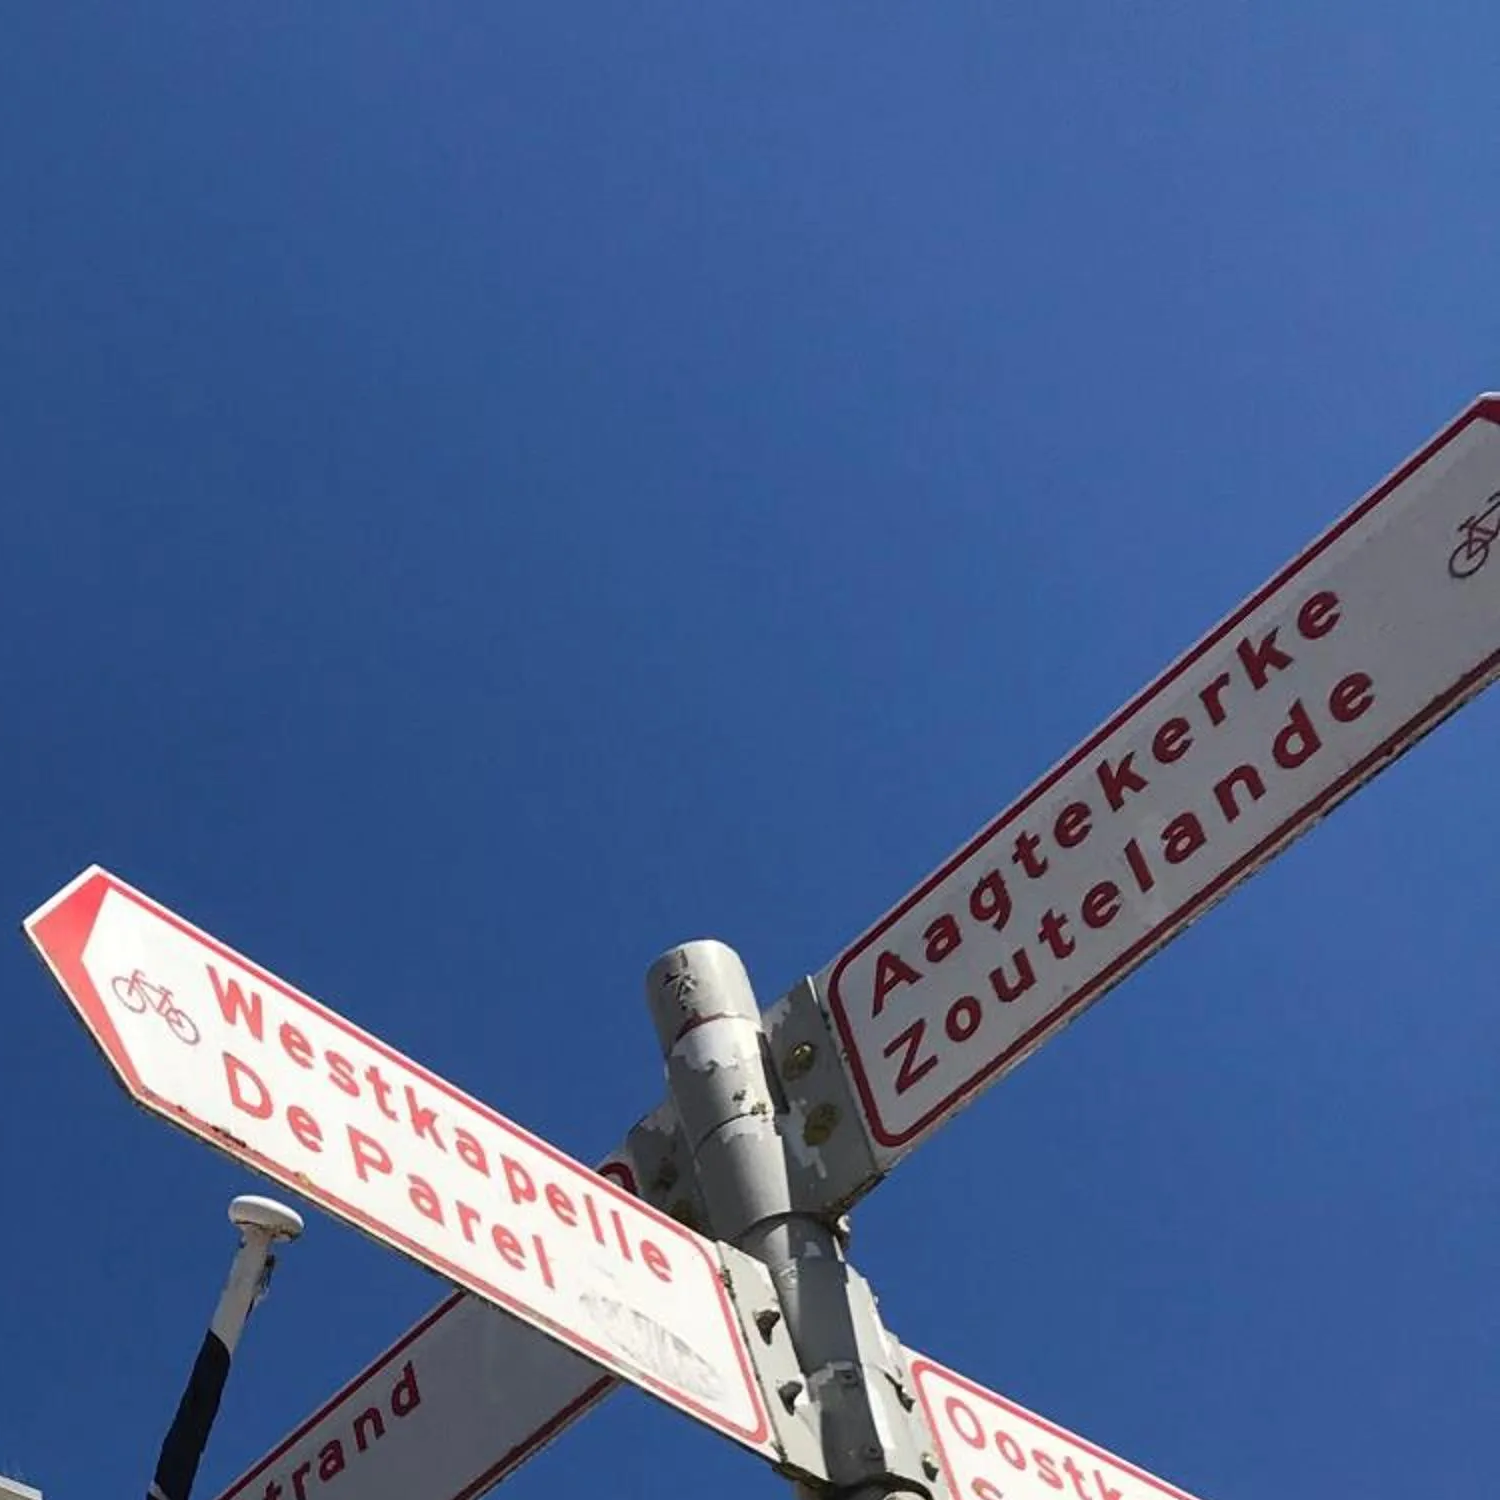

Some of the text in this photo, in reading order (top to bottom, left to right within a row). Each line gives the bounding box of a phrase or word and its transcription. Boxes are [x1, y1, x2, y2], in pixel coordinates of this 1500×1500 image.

[870, 588, 1341, 1018] Aagtekerke
[883, 670, 1375, 1095] Zoutelande
[205, 962, 673, 1284] Westkapelle
[223, 1051, 556, 1290] De Parel
